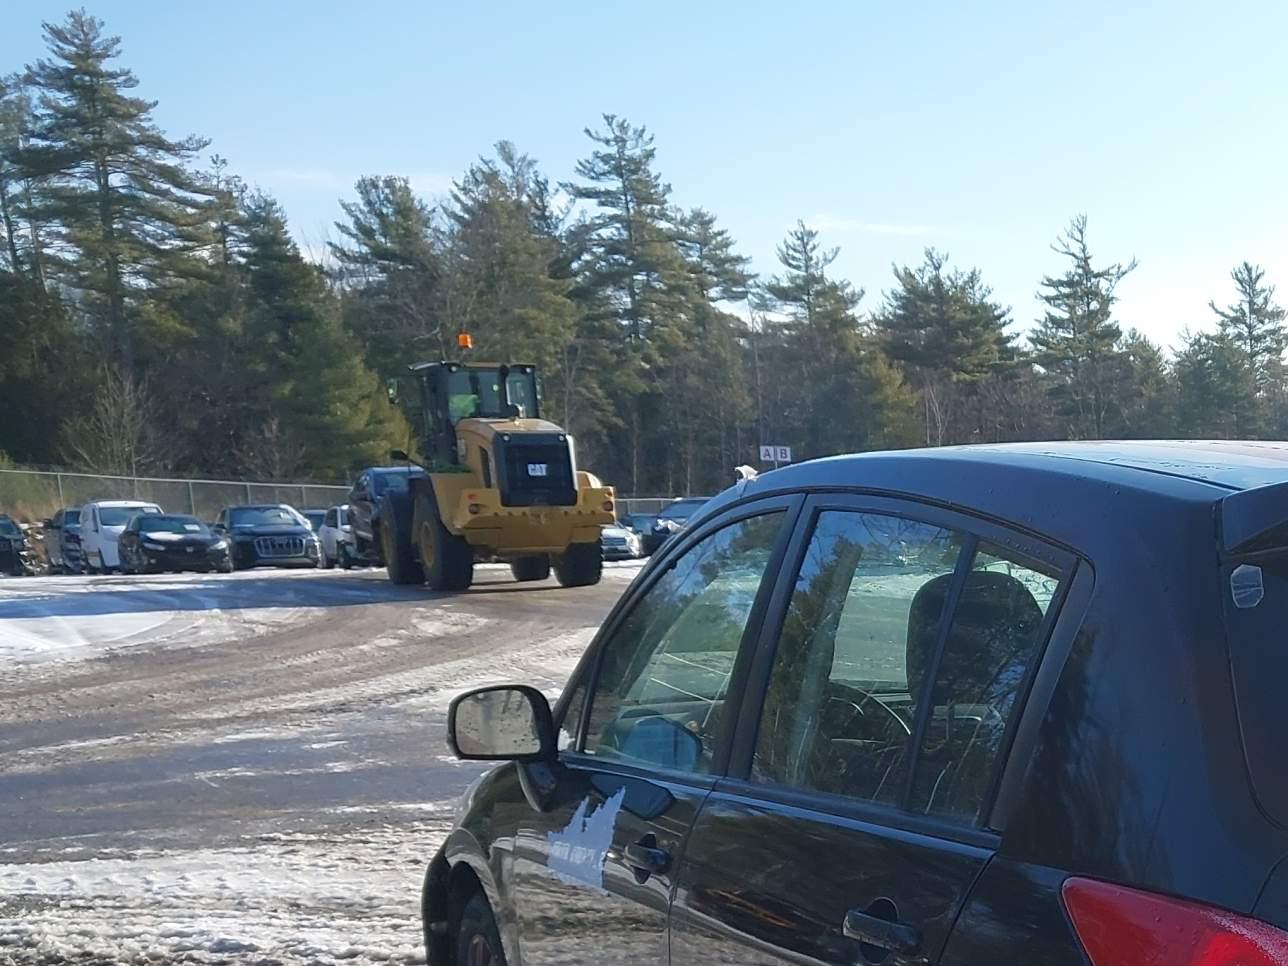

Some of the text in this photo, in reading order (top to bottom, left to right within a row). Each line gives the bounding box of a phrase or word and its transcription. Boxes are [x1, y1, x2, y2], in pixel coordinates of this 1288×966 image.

[763, 448, 788, 459] A B
[528, 463, 547, 476] CAT
